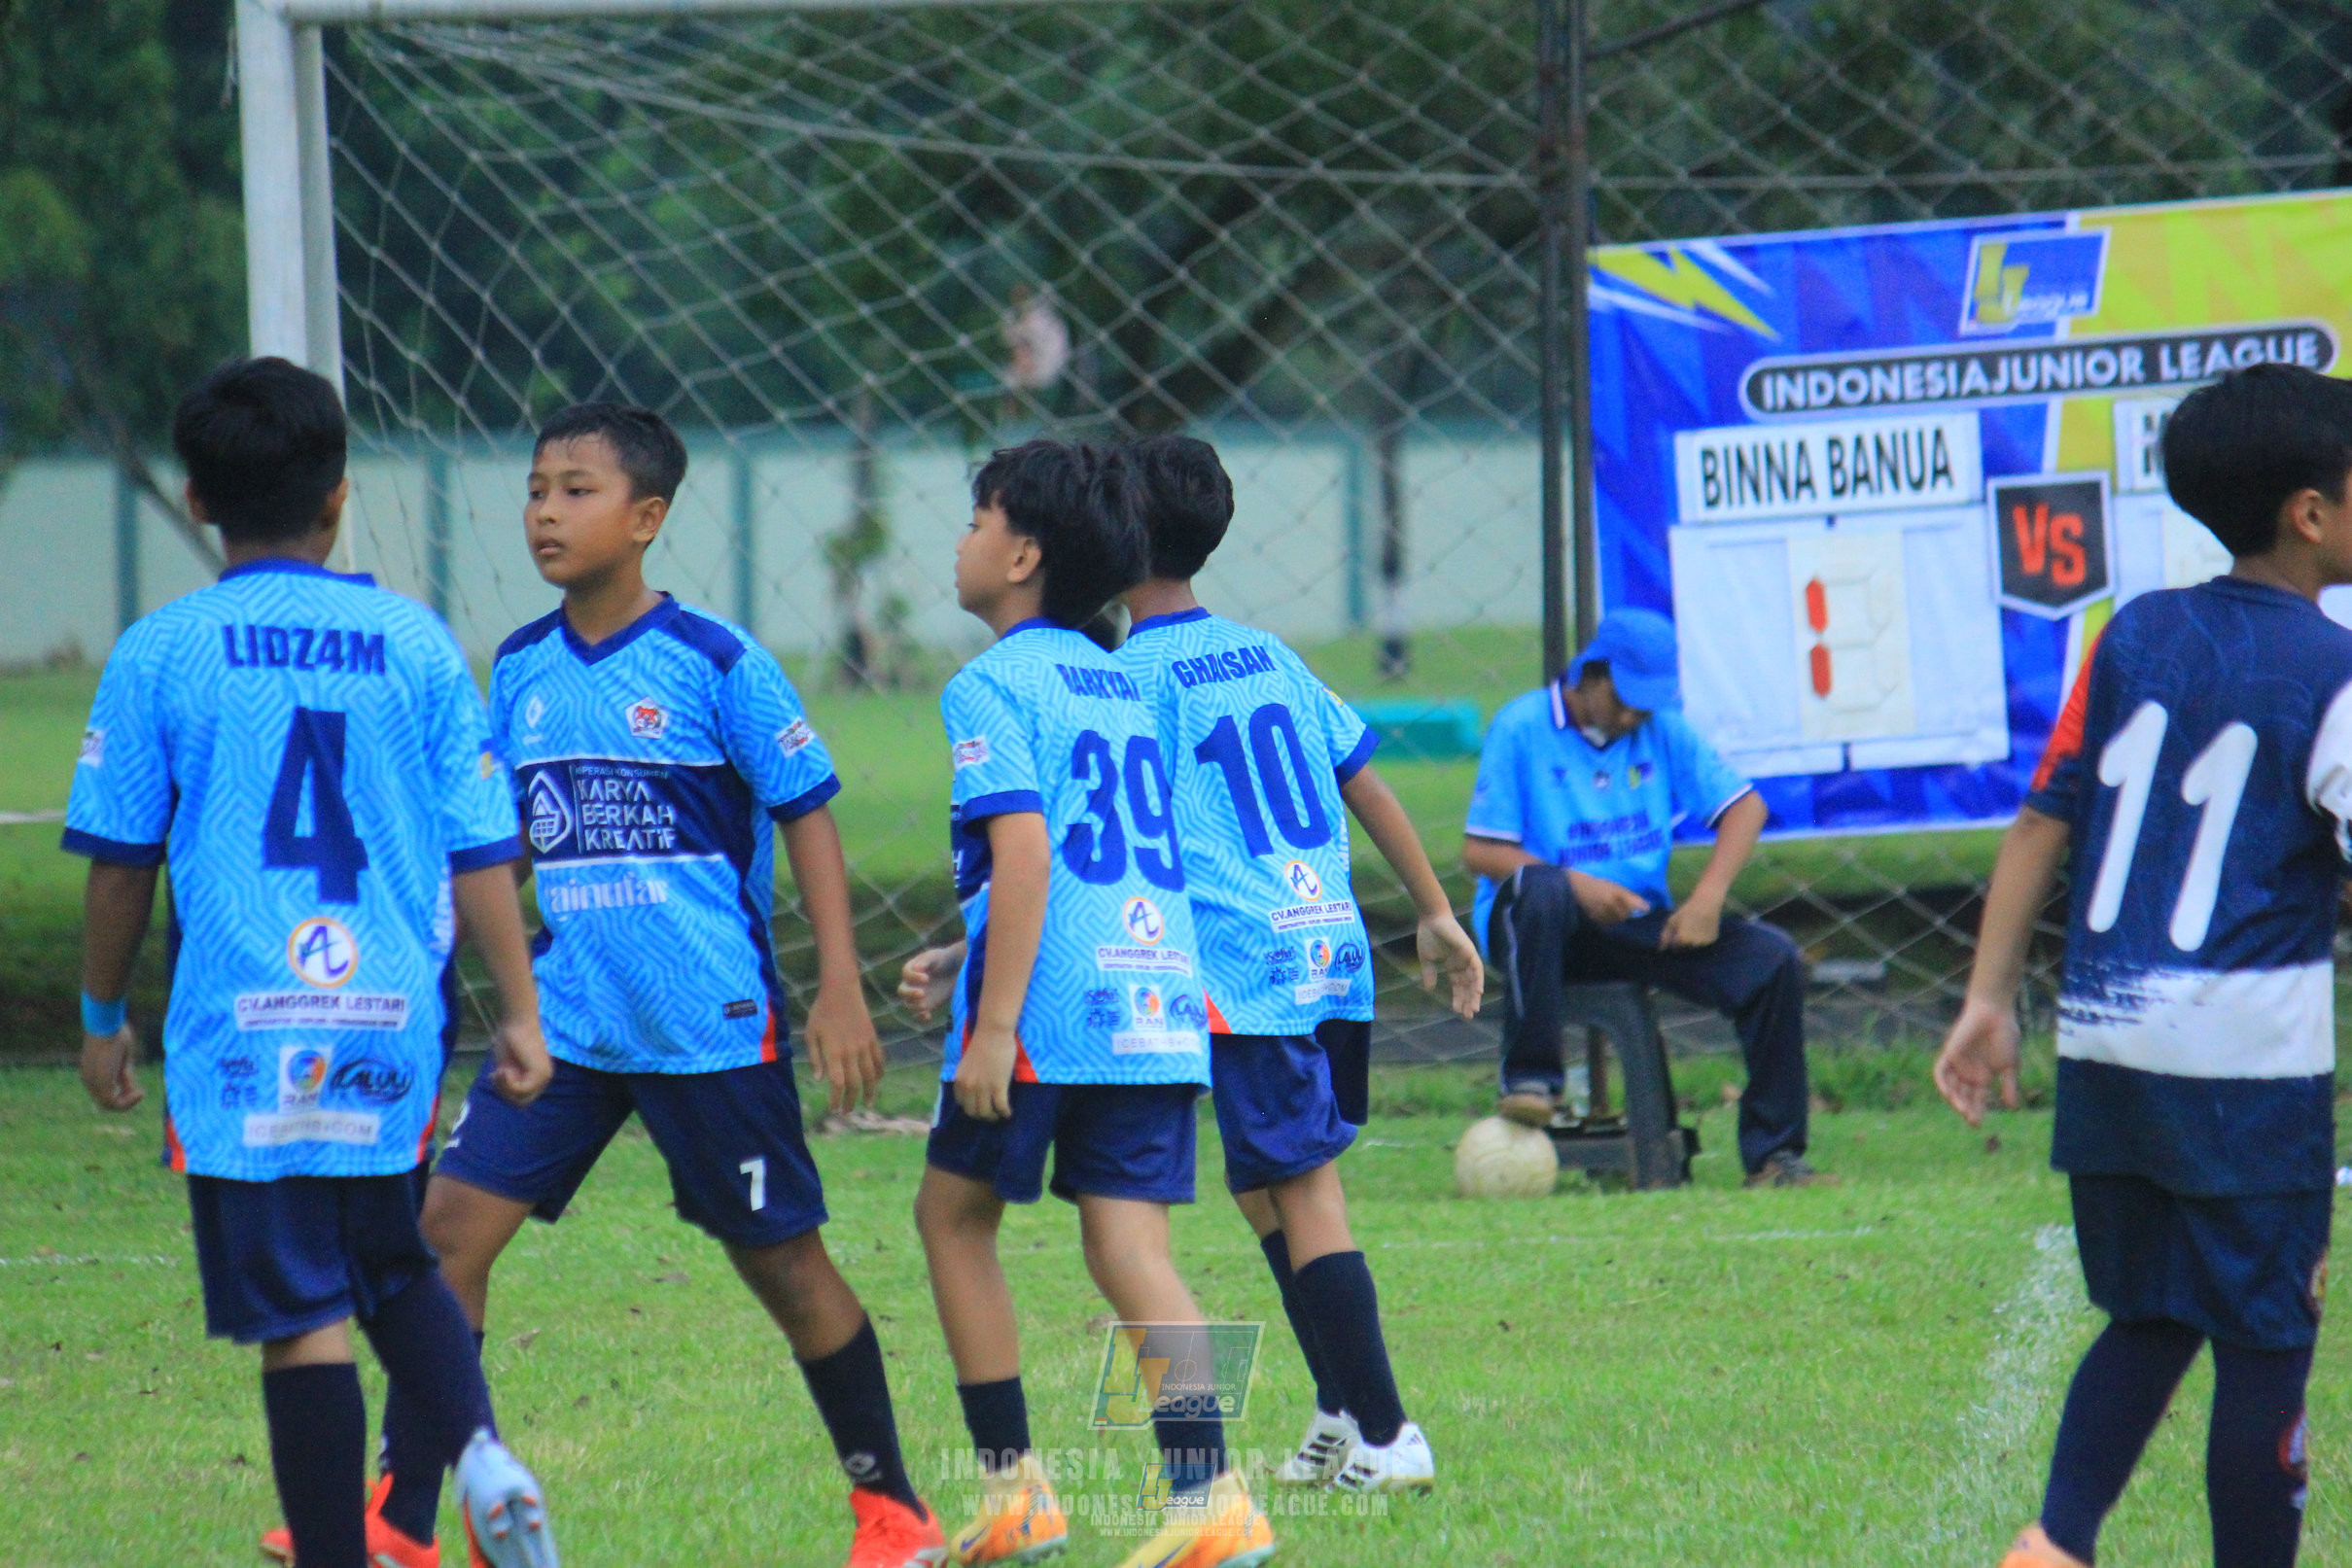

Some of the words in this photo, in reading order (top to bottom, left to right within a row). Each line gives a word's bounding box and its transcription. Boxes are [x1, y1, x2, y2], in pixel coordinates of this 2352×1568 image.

[2159, 333, 2320, 382] LEAGUE
[1701, 436, 1819, 508] BINNA
[1829, 427, 1954, 498] BANUA
[221, 623, 386, 677] LIDZ4M
[1805, 576, 1832, 700] 1
[1171, 645, 1278, 689] GHAISAN
[262, 706, 369, 905] 4
[578, 779, 651, 802] KARYA
[1193, 703, 1332, 858] 10
[581, 803, 675, 826] BERKAH
[1061, 729, 1186, 893] 39
[2086, 699, 2259, 954] 11
[584, 827, 677, 851] KREATIF
[346, 996, 405, 1013] LESTARI
[738, 1159, 767, 1211] 7
